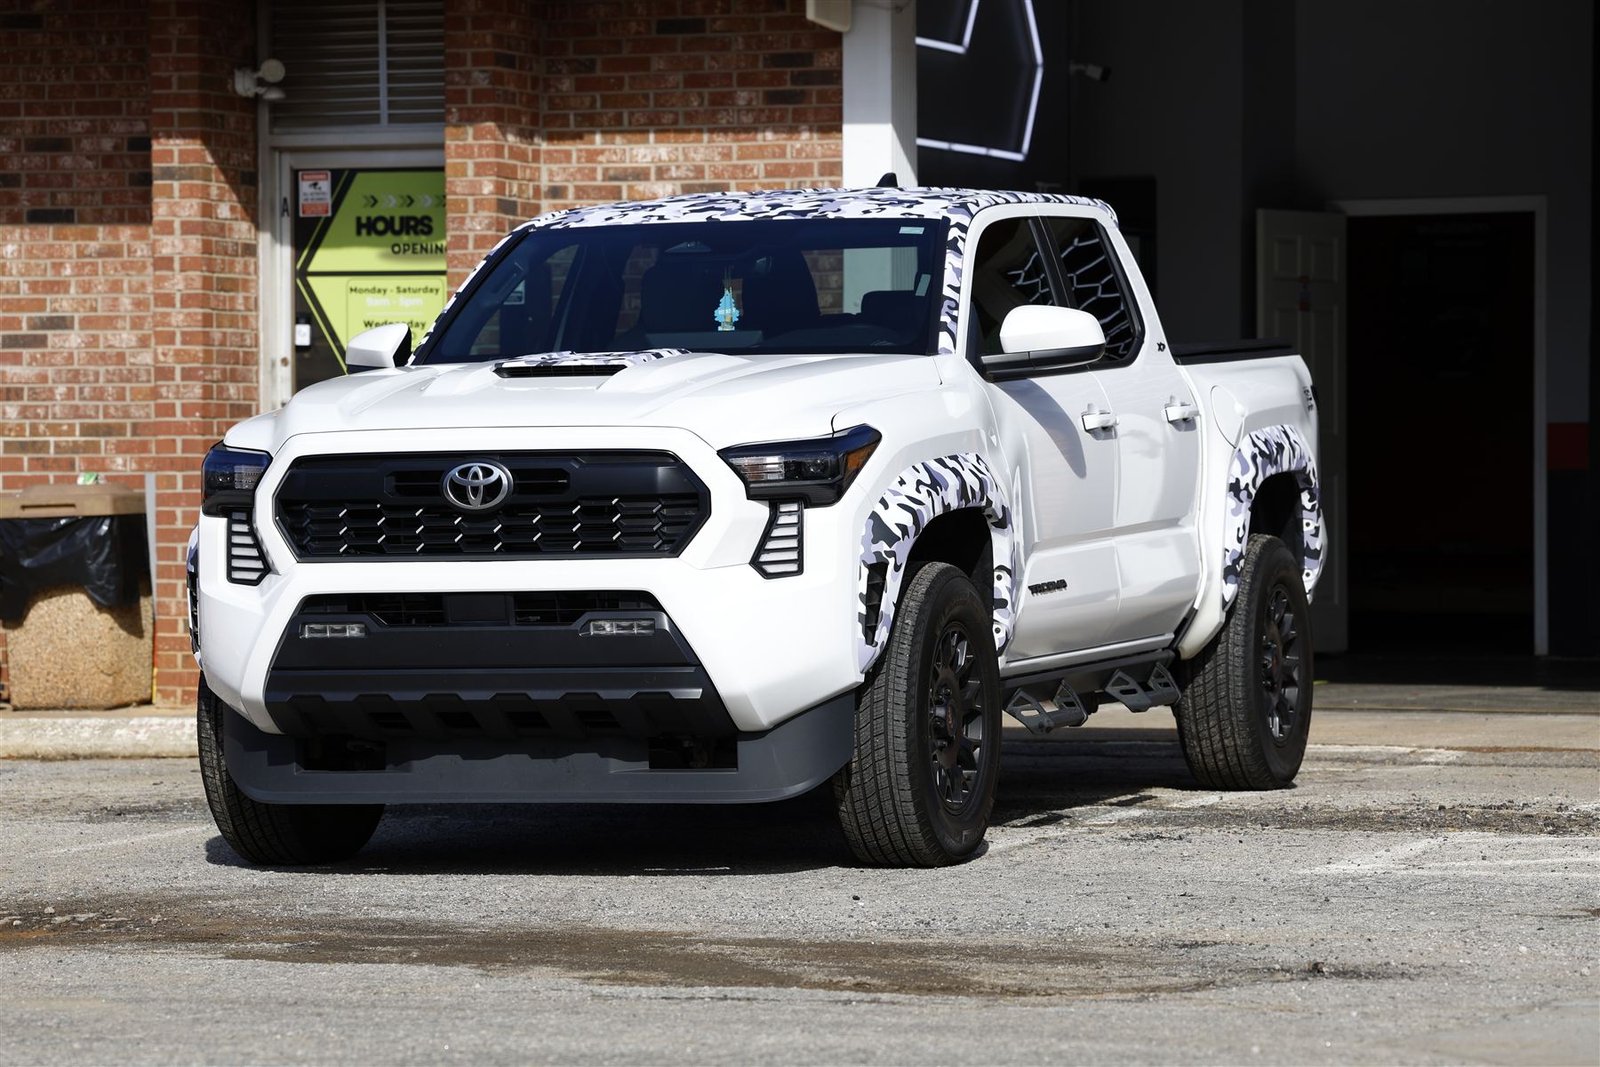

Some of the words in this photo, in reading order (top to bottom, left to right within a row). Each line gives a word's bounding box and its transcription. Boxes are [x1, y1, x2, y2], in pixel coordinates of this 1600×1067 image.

[280, 196, 290, 217] A
[355, 215, 433, 236] HOURS
[391, 243, 447, 255] OPENIN
[349, 286, 388, 296] Monday
[396, 286, 440, 296] Saturday
